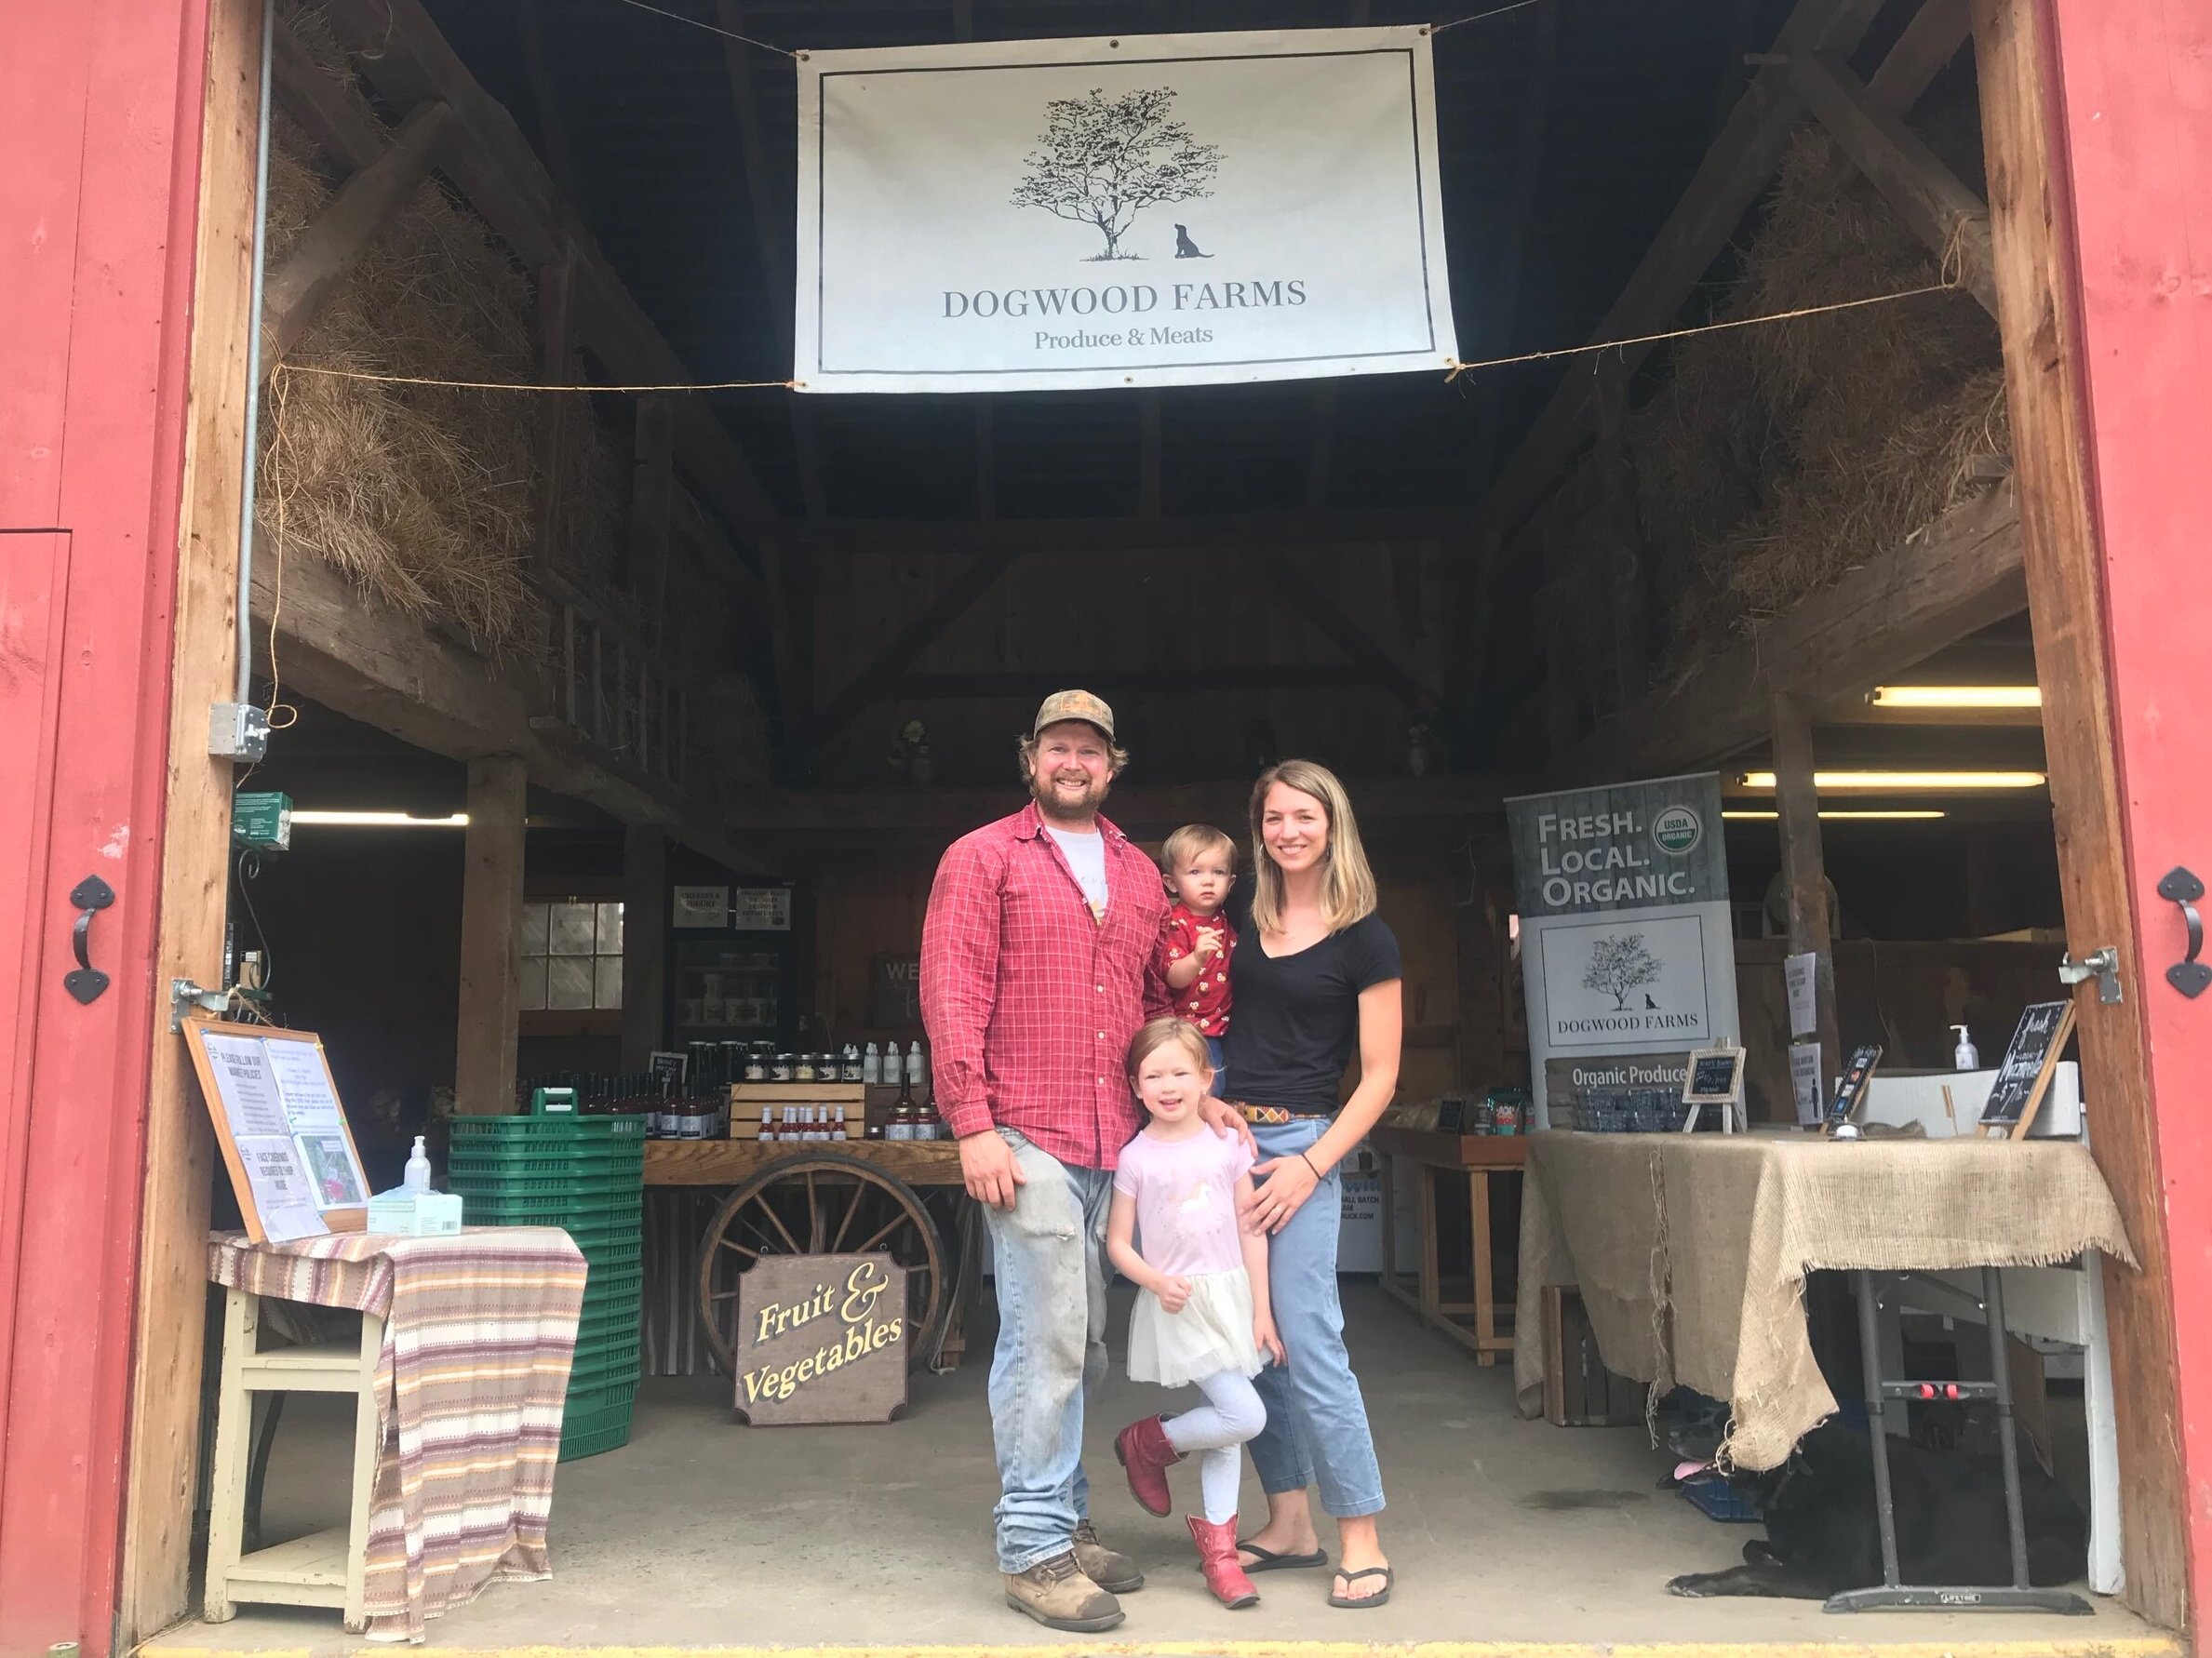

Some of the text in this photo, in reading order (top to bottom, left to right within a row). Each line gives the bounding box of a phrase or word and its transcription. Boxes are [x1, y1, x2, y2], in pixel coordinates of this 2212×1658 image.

[942, 280, 1307, 317] DOGWOOD FARMS
[1035, 326, 1213, 350] Produce & Meats
[1538, 811, 1642, 843] FRESH.
[1662, 831, 1692, 841] ORGANIC
[1664, 819, 1688, 829] USDA
[1540, 845, 1651, 876] LOCAL.
[1542, 872, 1696, 906] ORGANIC.
[1558, 1013, 1698, 1034] DOGWOOD FARMS
[1573, 1067, 1627, 1088] Organic
[1629, 1064, 1687, 1084] Produce
[756, 1262, 889, 1343] Fruit &
[743, 1317, 902, 1405] Vegetables
